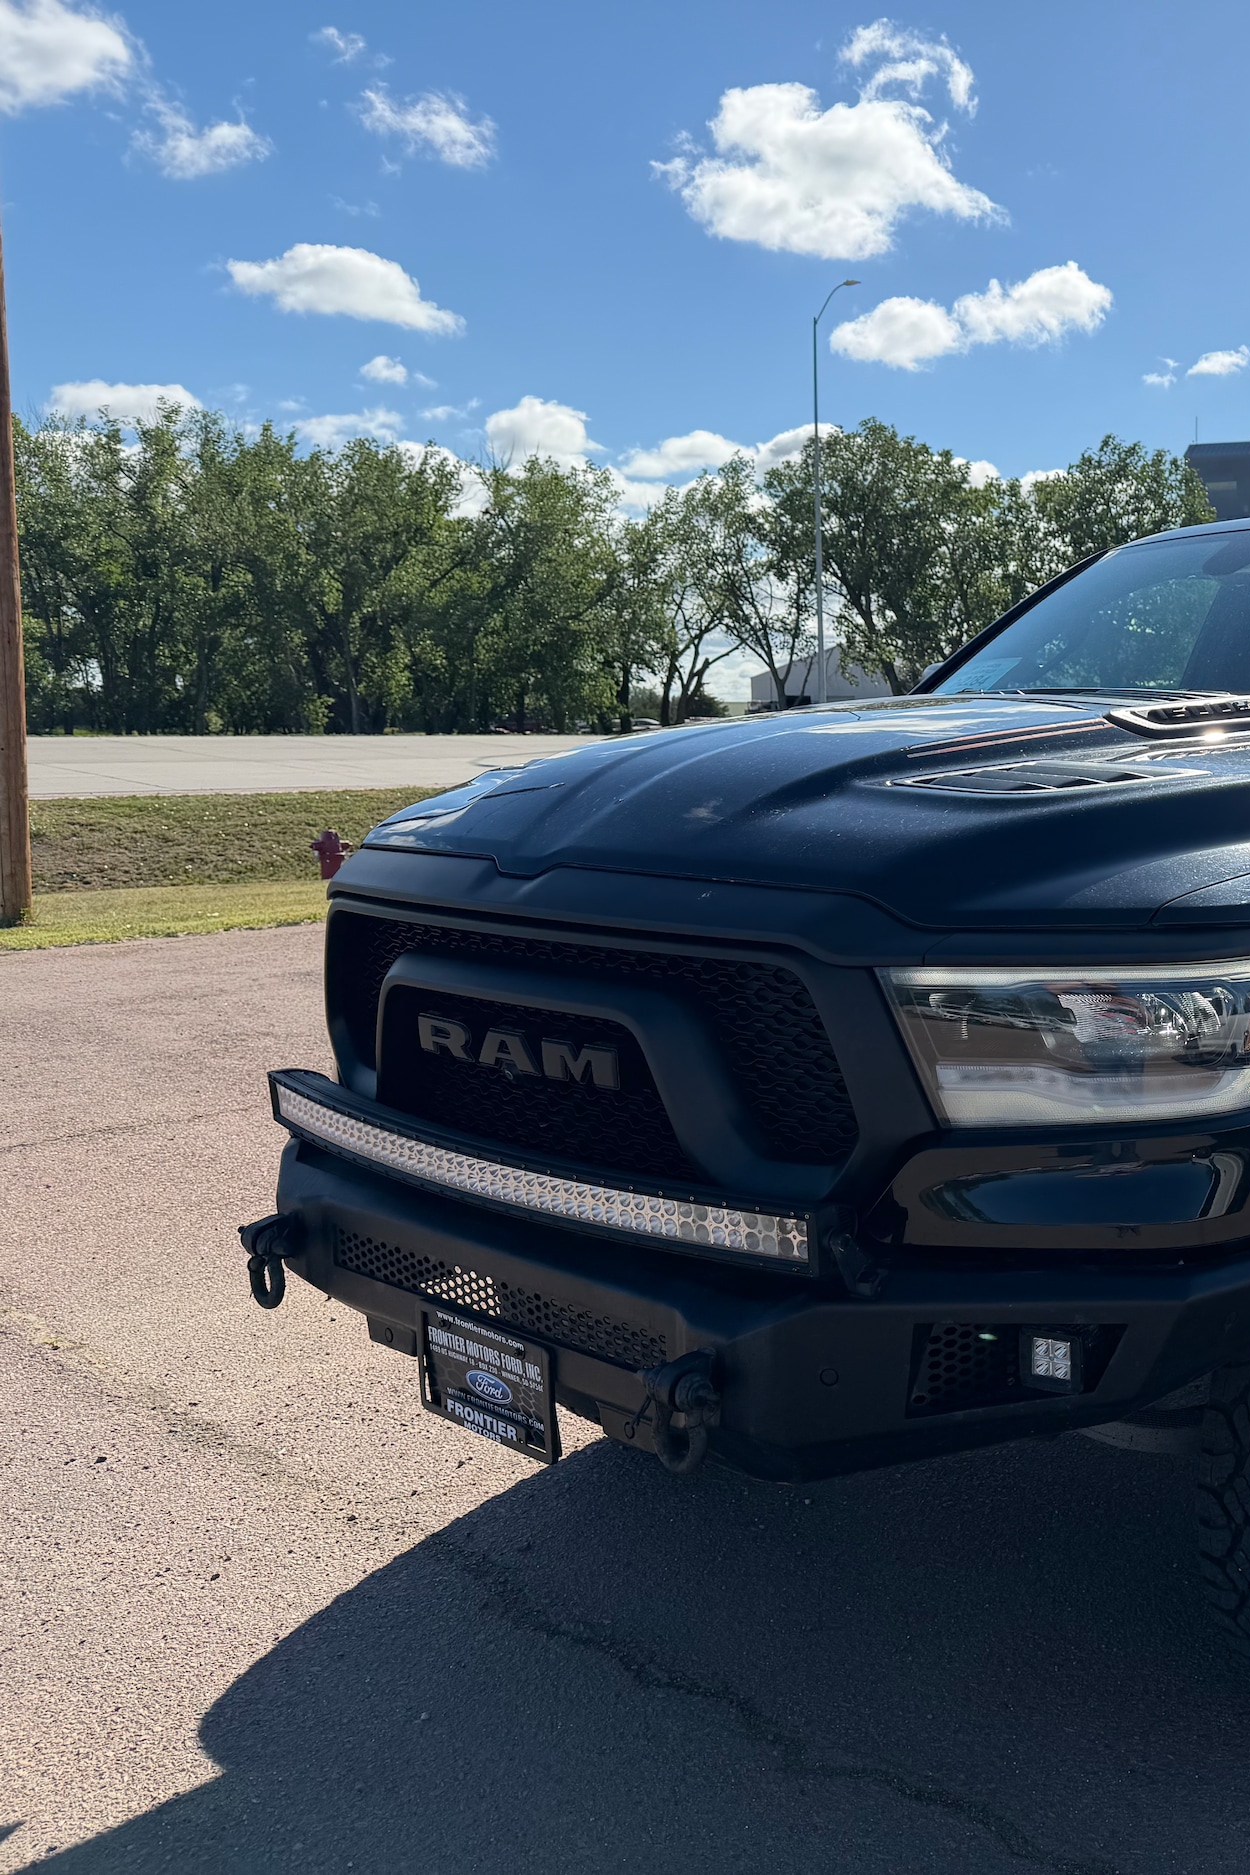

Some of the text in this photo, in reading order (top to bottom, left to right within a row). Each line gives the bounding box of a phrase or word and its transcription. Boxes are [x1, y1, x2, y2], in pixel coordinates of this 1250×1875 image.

[418, 1012, 620, 1090] RAM
[436, 1310, 525, 1351] www.frontiermotors.com
[428, 1325, 544, 1384] FRONTIER MOTORS FORD, INC.
[475, 1374, 503, 1400] Ford
[447, 1398, 518, 1442] FRONTIER
[464, 1420, 502, 1443] MOTORS
